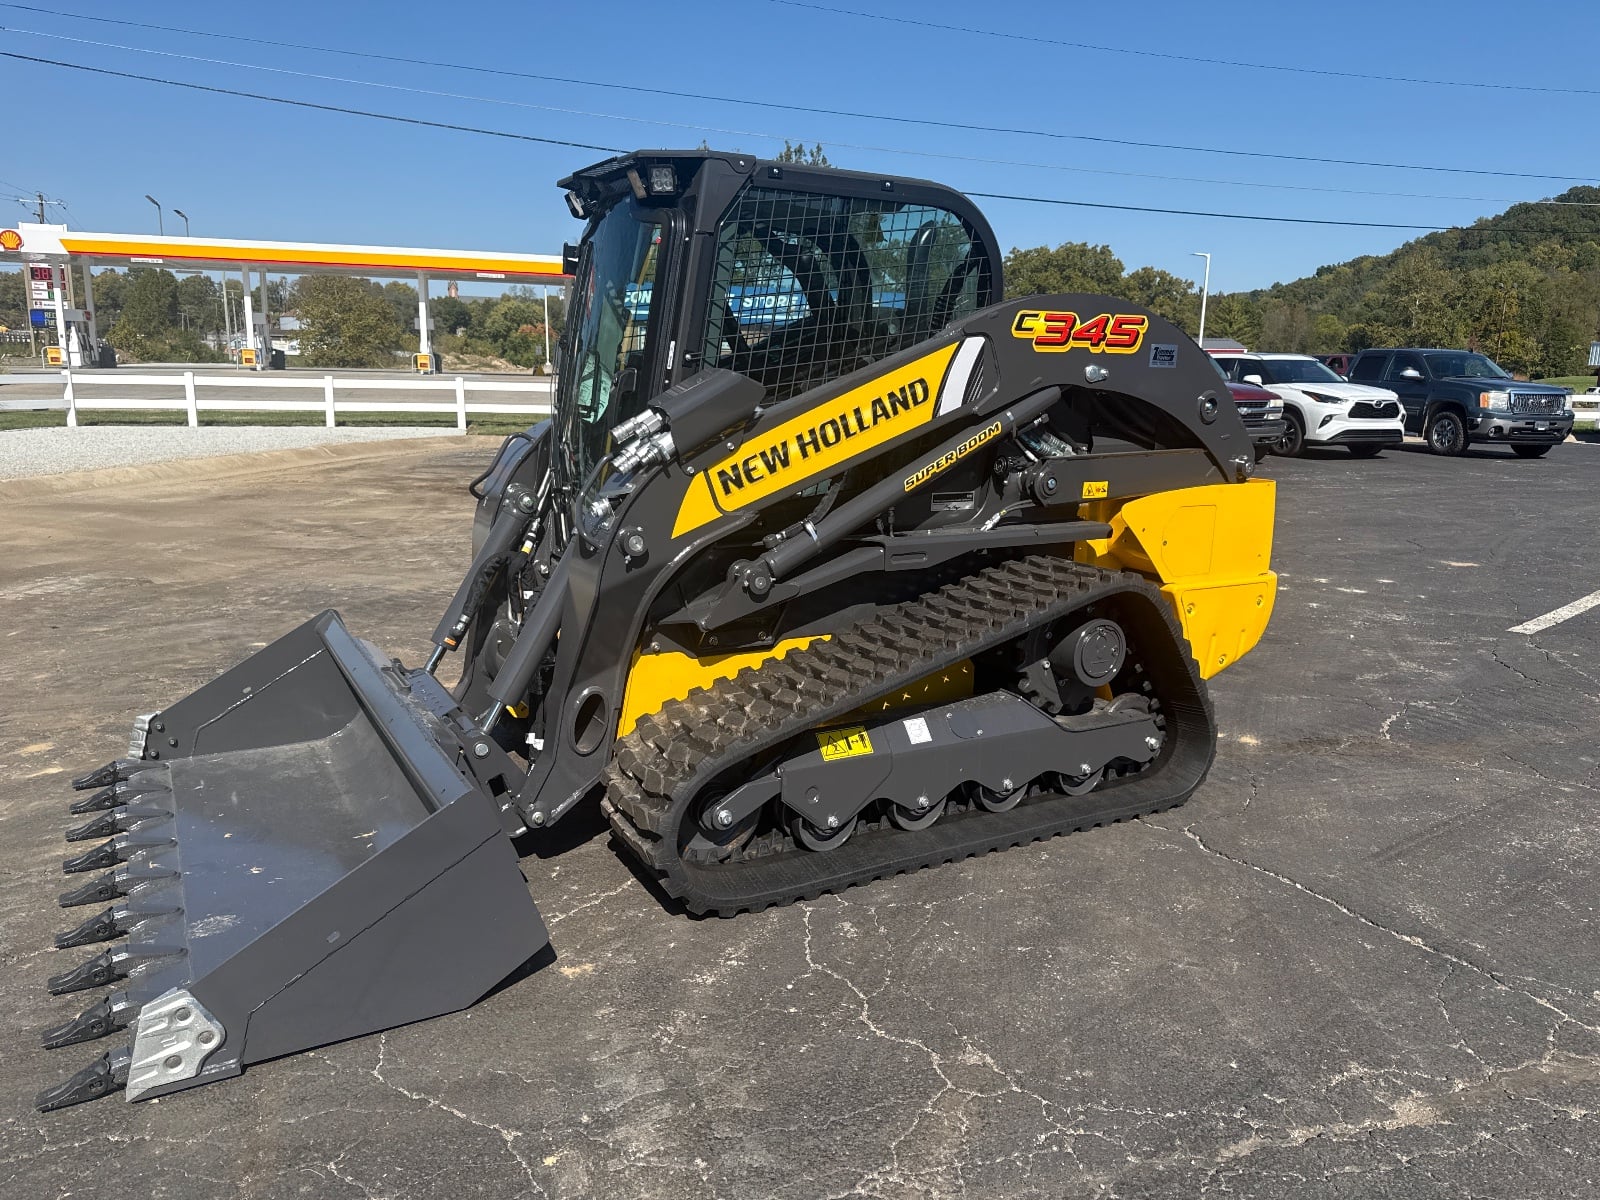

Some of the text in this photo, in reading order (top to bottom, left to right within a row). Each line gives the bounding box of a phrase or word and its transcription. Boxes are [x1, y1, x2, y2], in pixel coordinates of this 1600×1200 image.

[1012, 310, 1149, 354] C345
[717, 377, 930, 496] NEW HOLLAND
[904, 421, 1002, 492] SUPER BOOM
